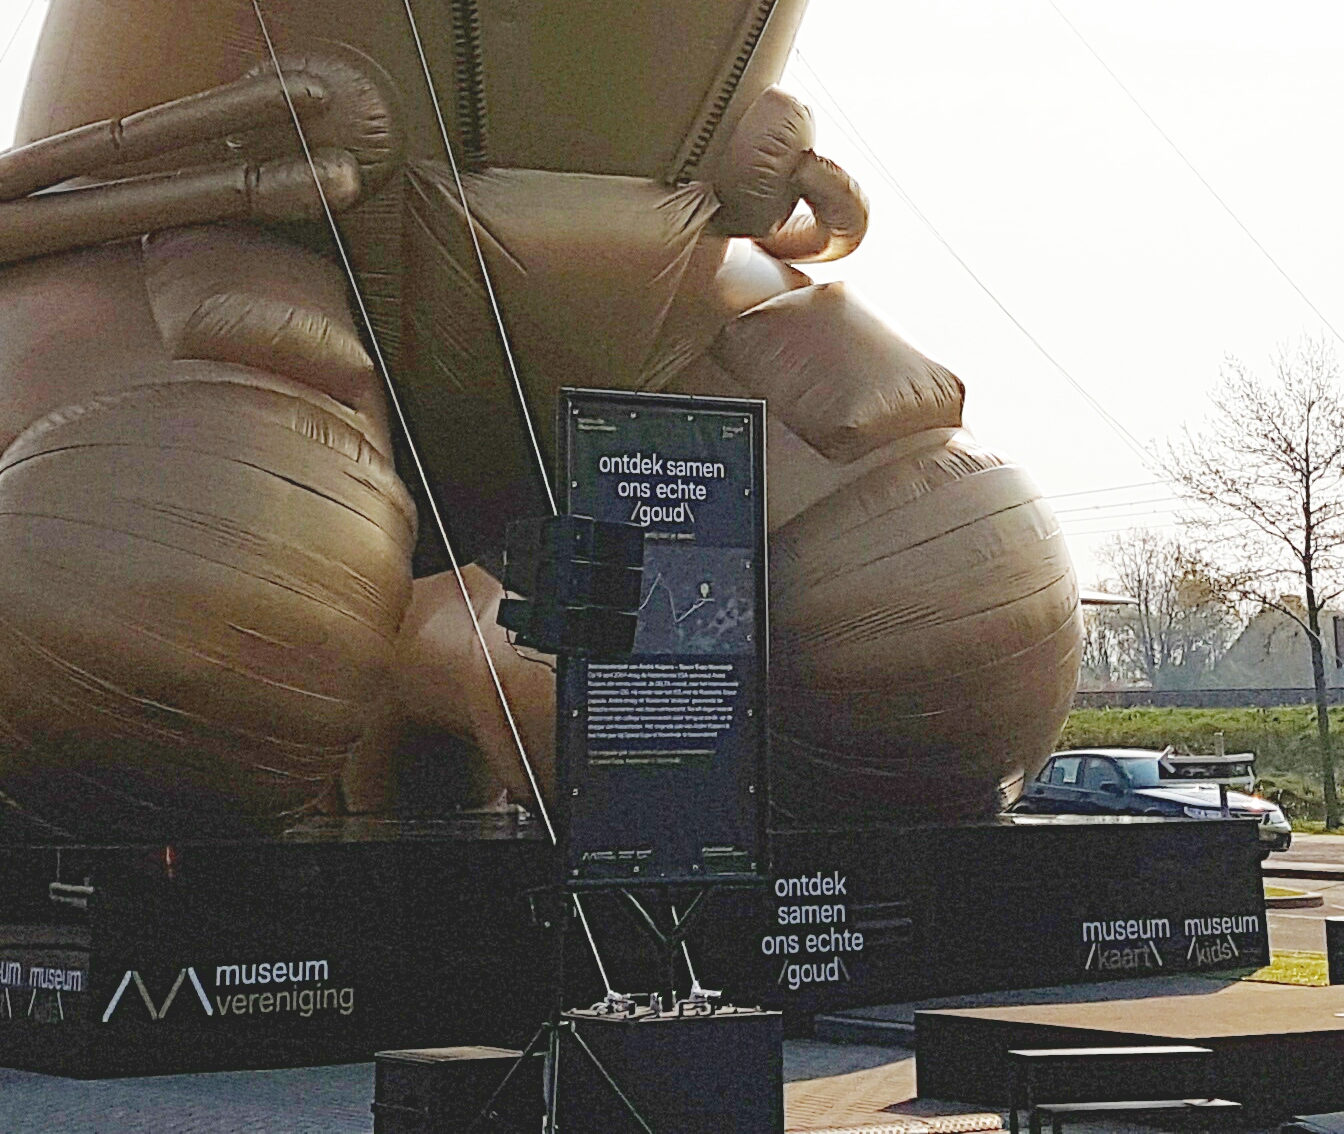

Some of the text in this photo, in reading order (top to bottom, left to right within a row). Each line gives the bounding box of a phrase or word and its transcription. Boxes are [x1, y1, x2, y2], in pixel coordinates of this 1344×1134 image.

[599, 453, 725, 478] ontdek samen
[618, 479, 707, 500] ons echte
[774, 870, 847, 897] ontdek
[777, 904, 846, 925] samen
[1184, 915, 1259, 936] museum
[761, 927, 864, 955] ons echte
[1083, 919, 1170, 942] museum
[29, 967, 81, 991] museum
[216, 960, 329, 986] museum
[216, 983, 354, 1017] vereniging
